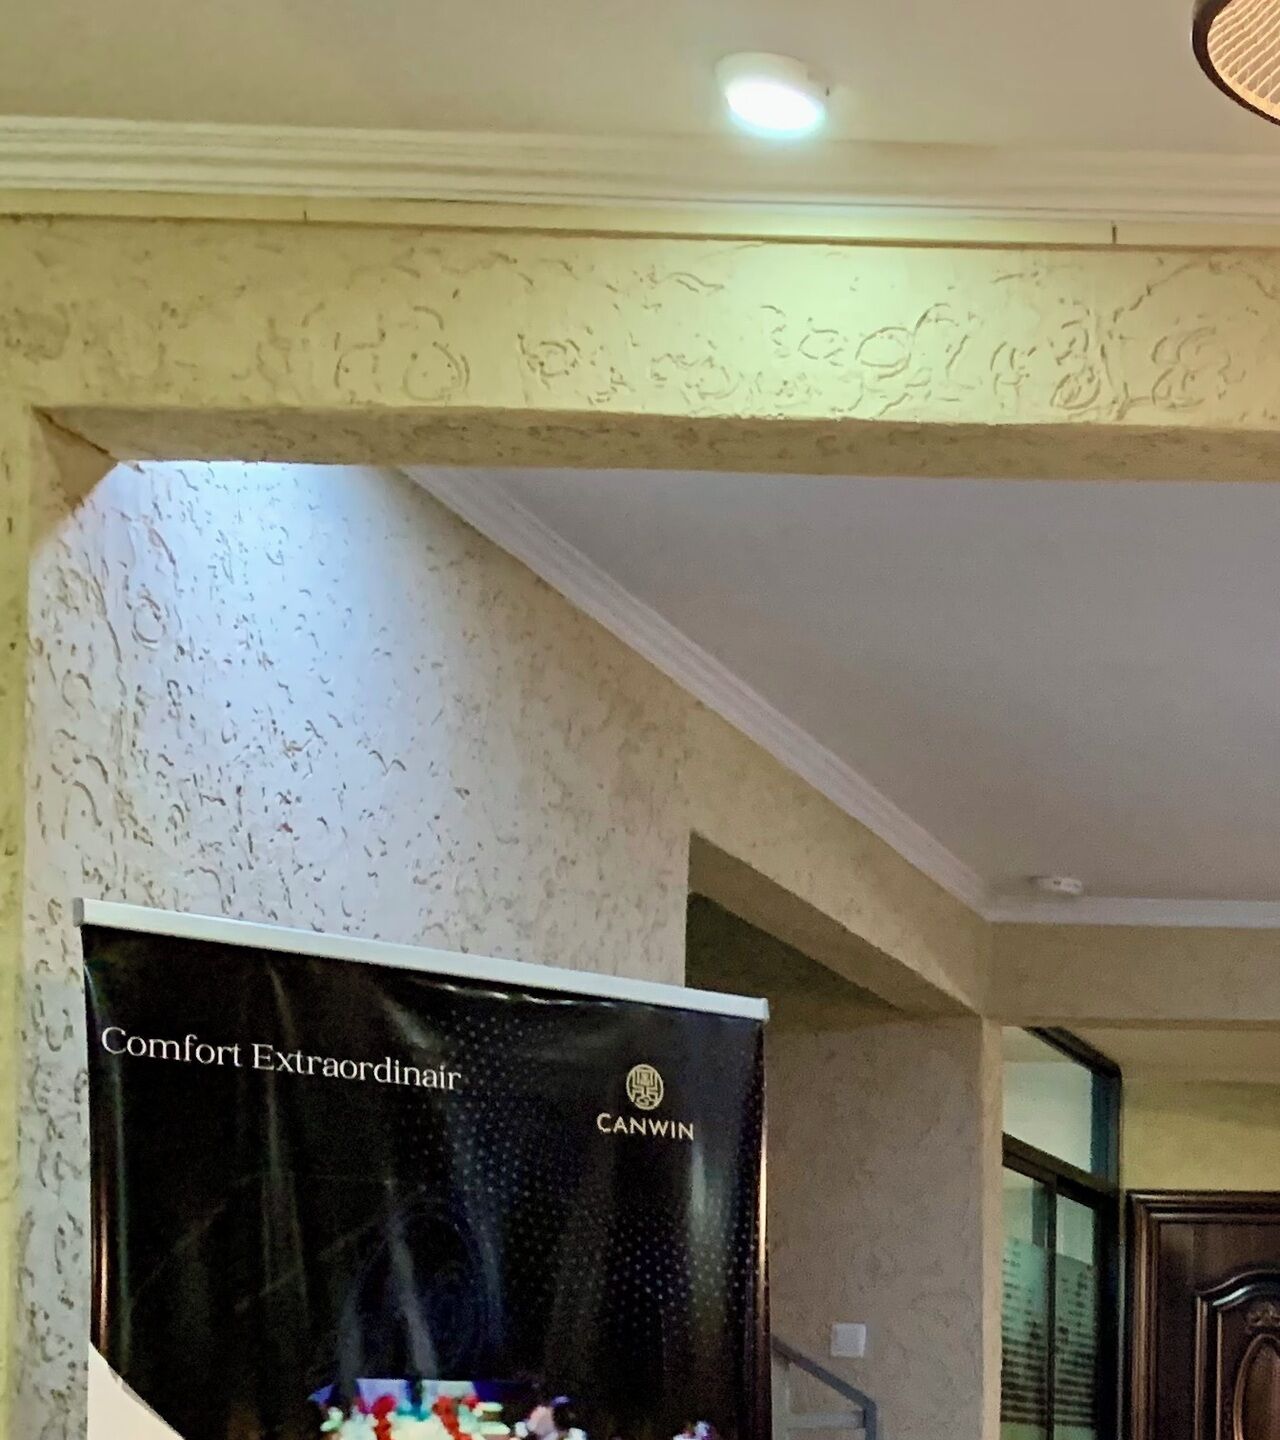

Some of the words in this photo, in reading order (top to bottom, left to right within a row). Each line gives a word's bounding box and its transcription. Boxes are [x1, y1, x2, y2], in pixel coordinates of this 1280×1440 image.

[101, 1026, 243, 1067] Comfort
[251, 1043, 462, 1090] Extraordinair
[597, 1112, 694, 1140] CANWIN
